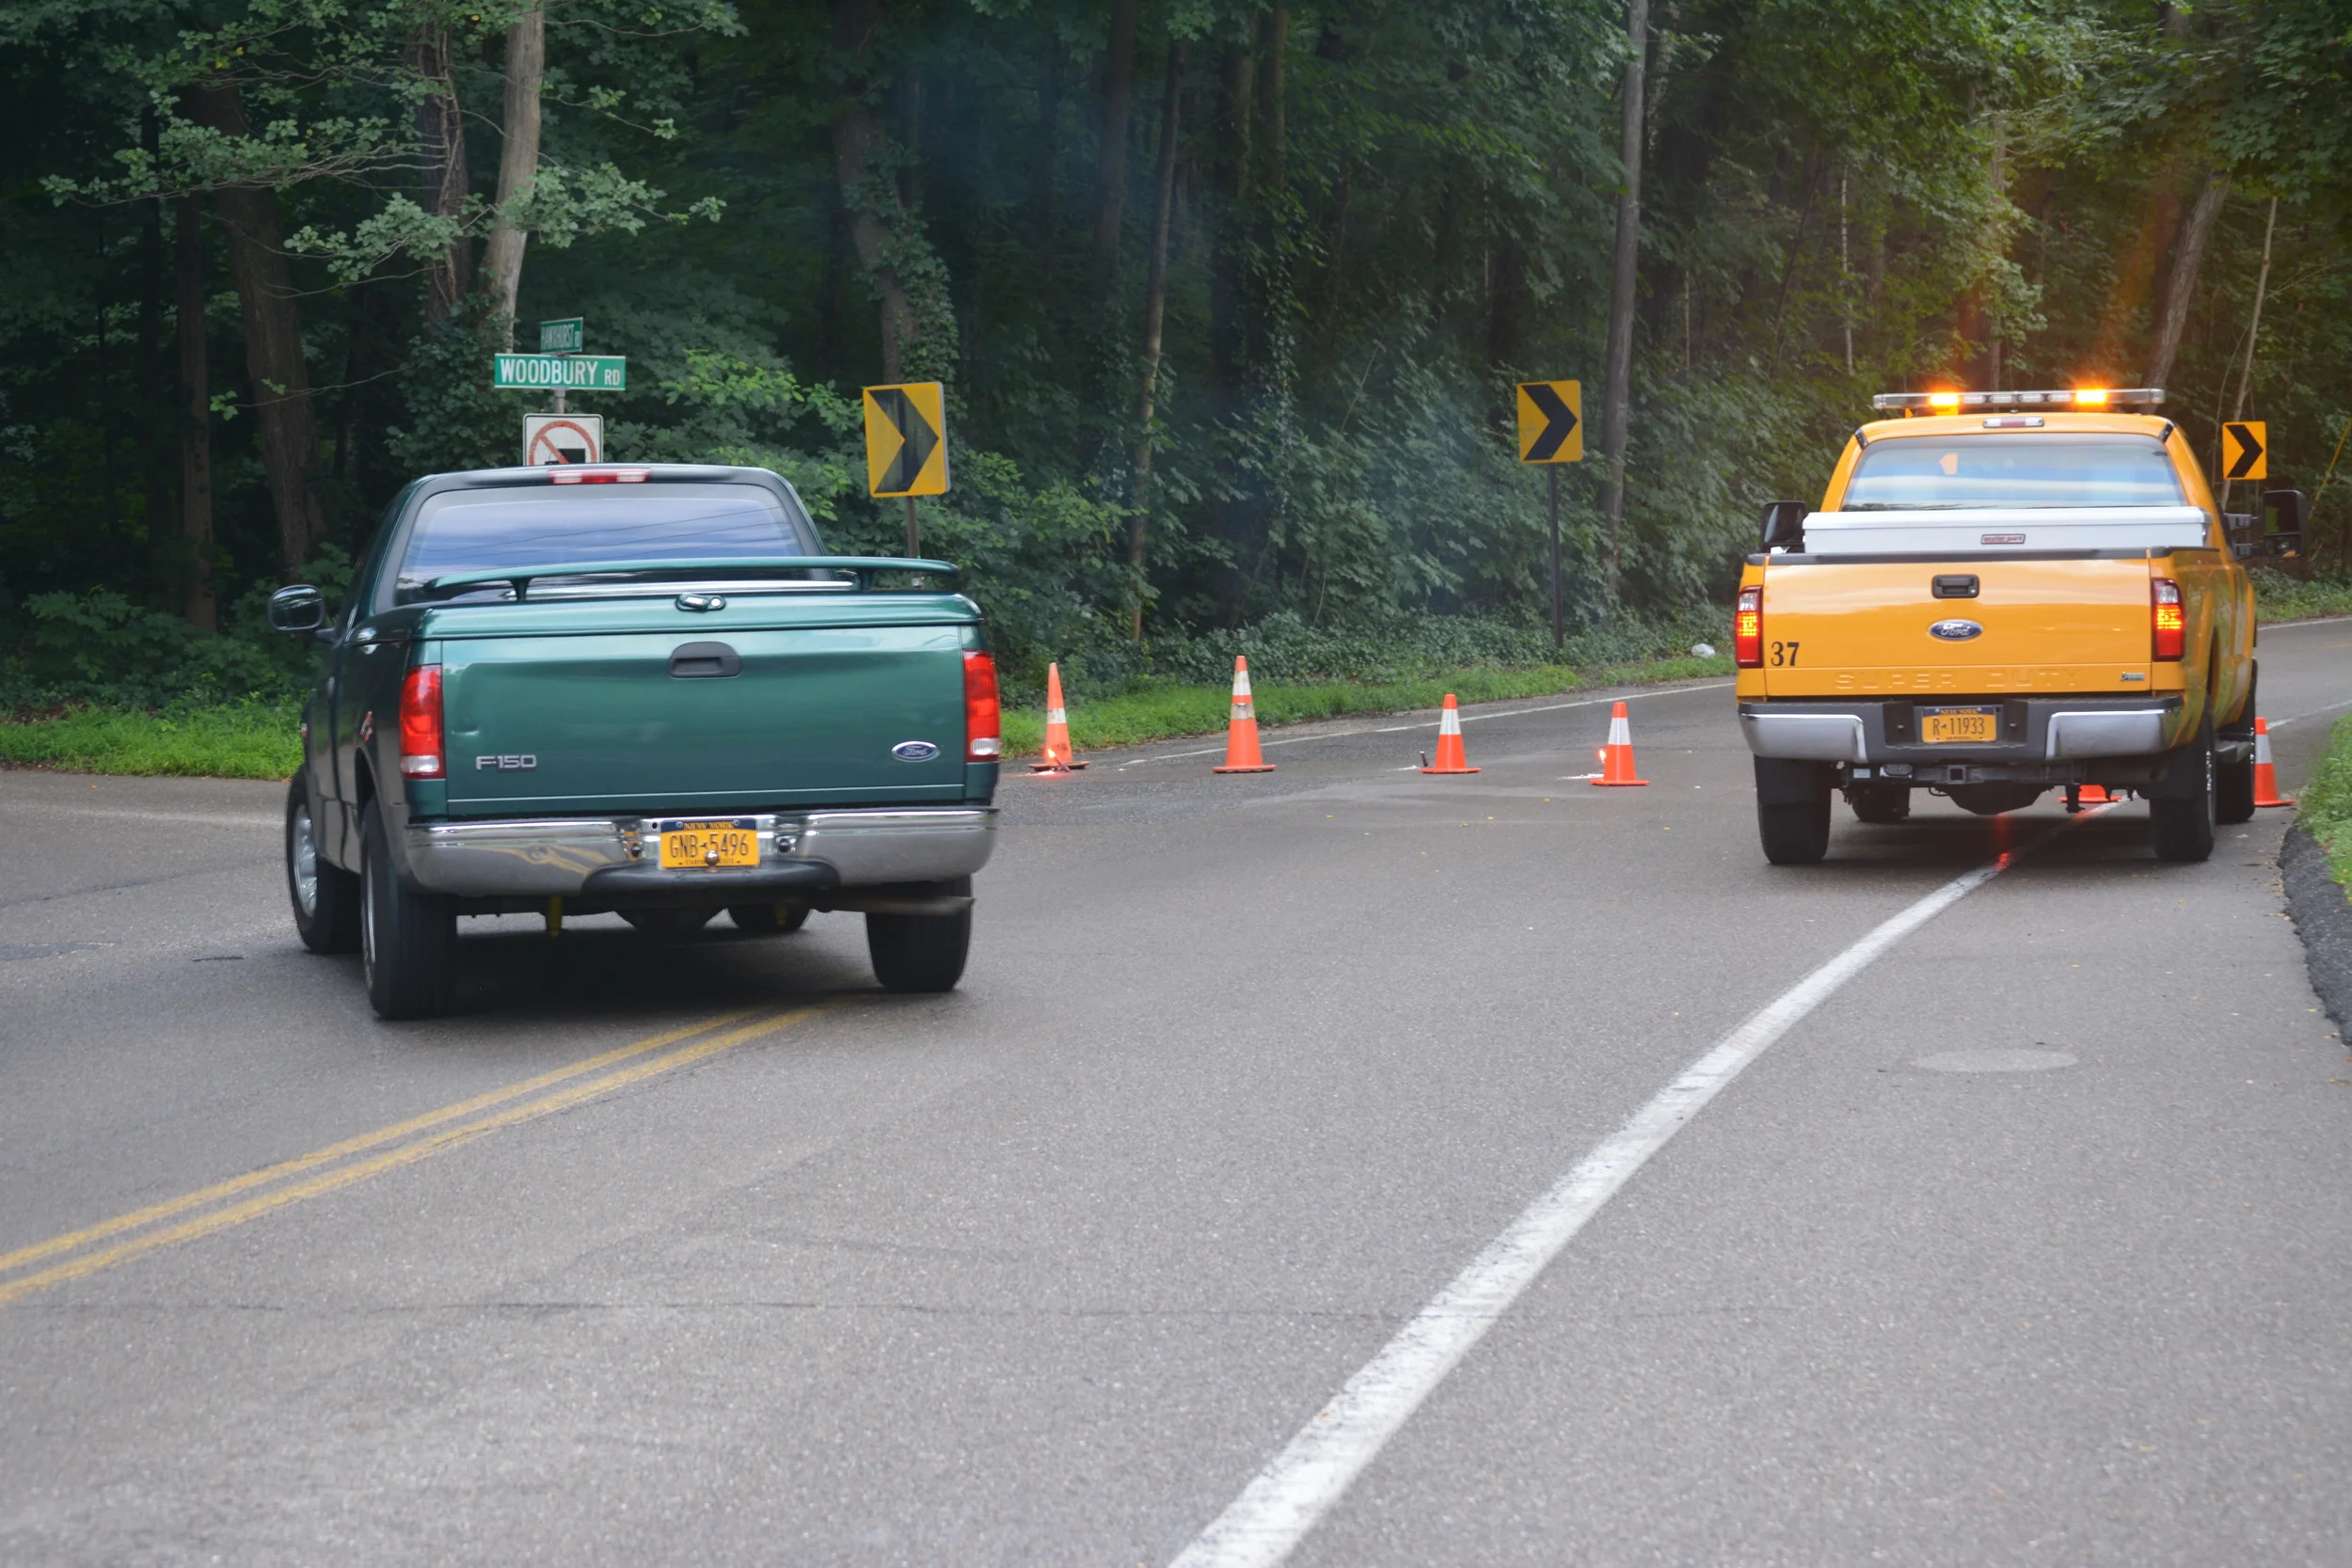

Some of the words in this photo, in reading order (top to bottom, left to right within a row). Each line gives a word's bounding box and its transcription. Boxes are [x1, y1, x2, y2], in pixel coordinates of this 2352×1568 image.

[500, 358, 598, 386] WOODBURY
[604, 369, 621, 386] RD
[1940, 623, 1971, 636] Ford
[1771, 641, 1800, 667] 37
[1836, 671, 1957, 689] SUPER
[1986, 669, 2081, 688] DUTY
[902, 745, 929, 756] Ford
[683, 822, 707, 831] NEW
[709, 821, 735, 830] YORK
